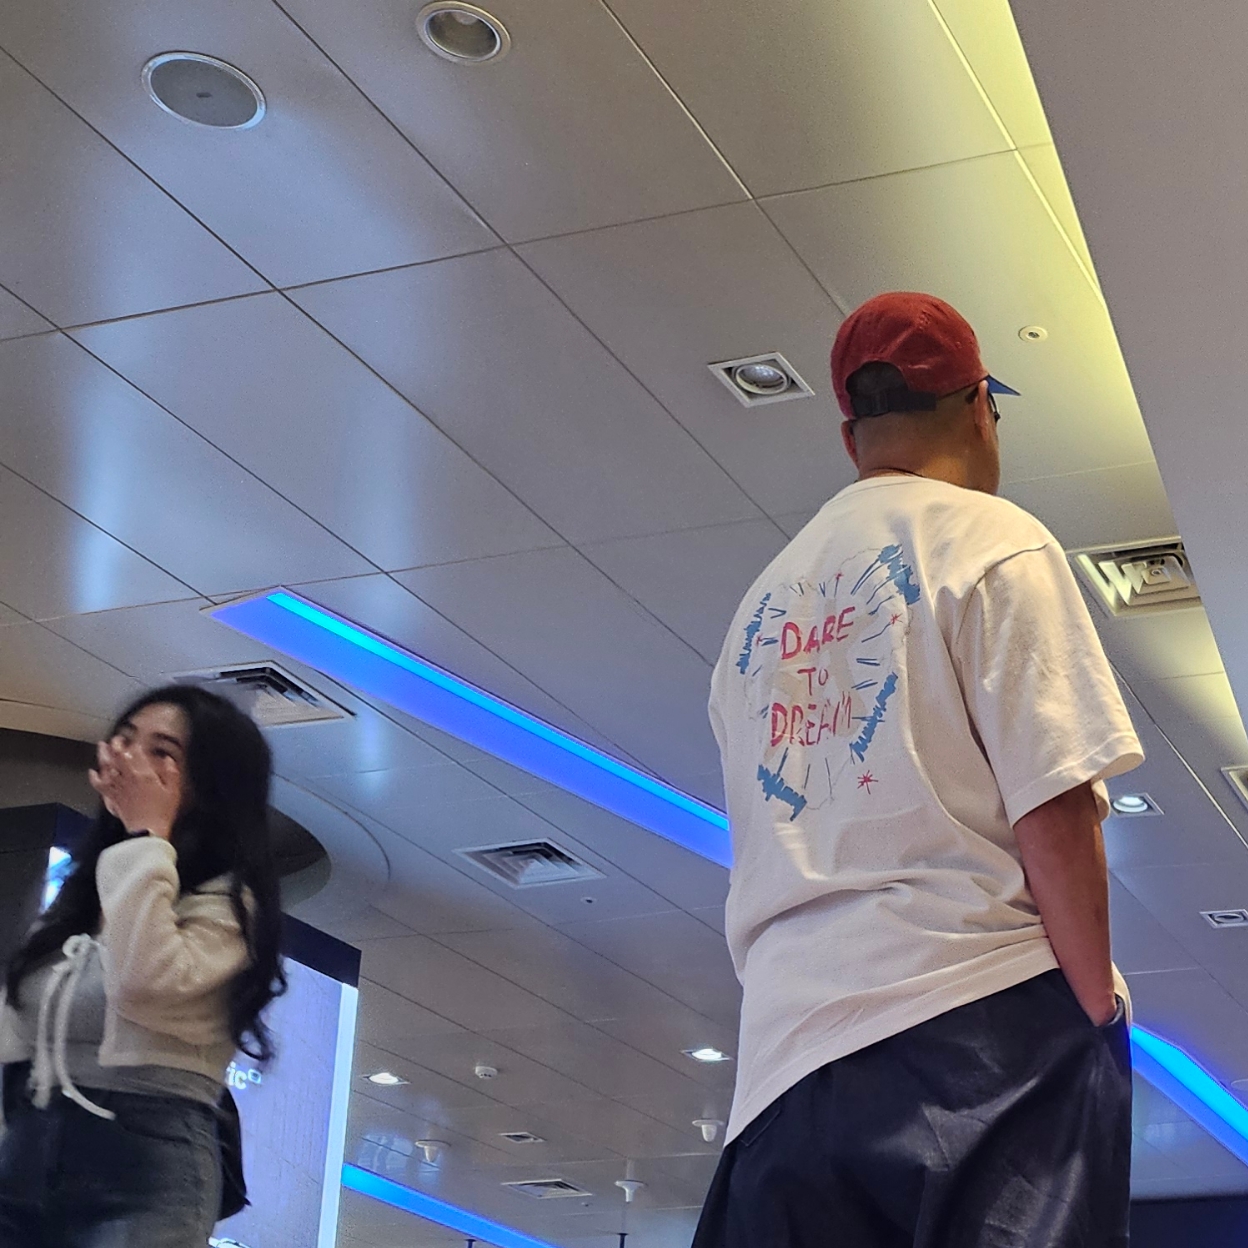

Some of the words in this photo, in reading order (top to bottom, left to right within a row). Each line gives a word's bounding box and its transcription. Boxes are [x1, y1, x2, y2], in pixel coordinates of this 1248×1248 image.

[780, 606, 856, 660] DARE
[797, 667, 829, 696] TO
[771, 691, 852, 747] DREAM
